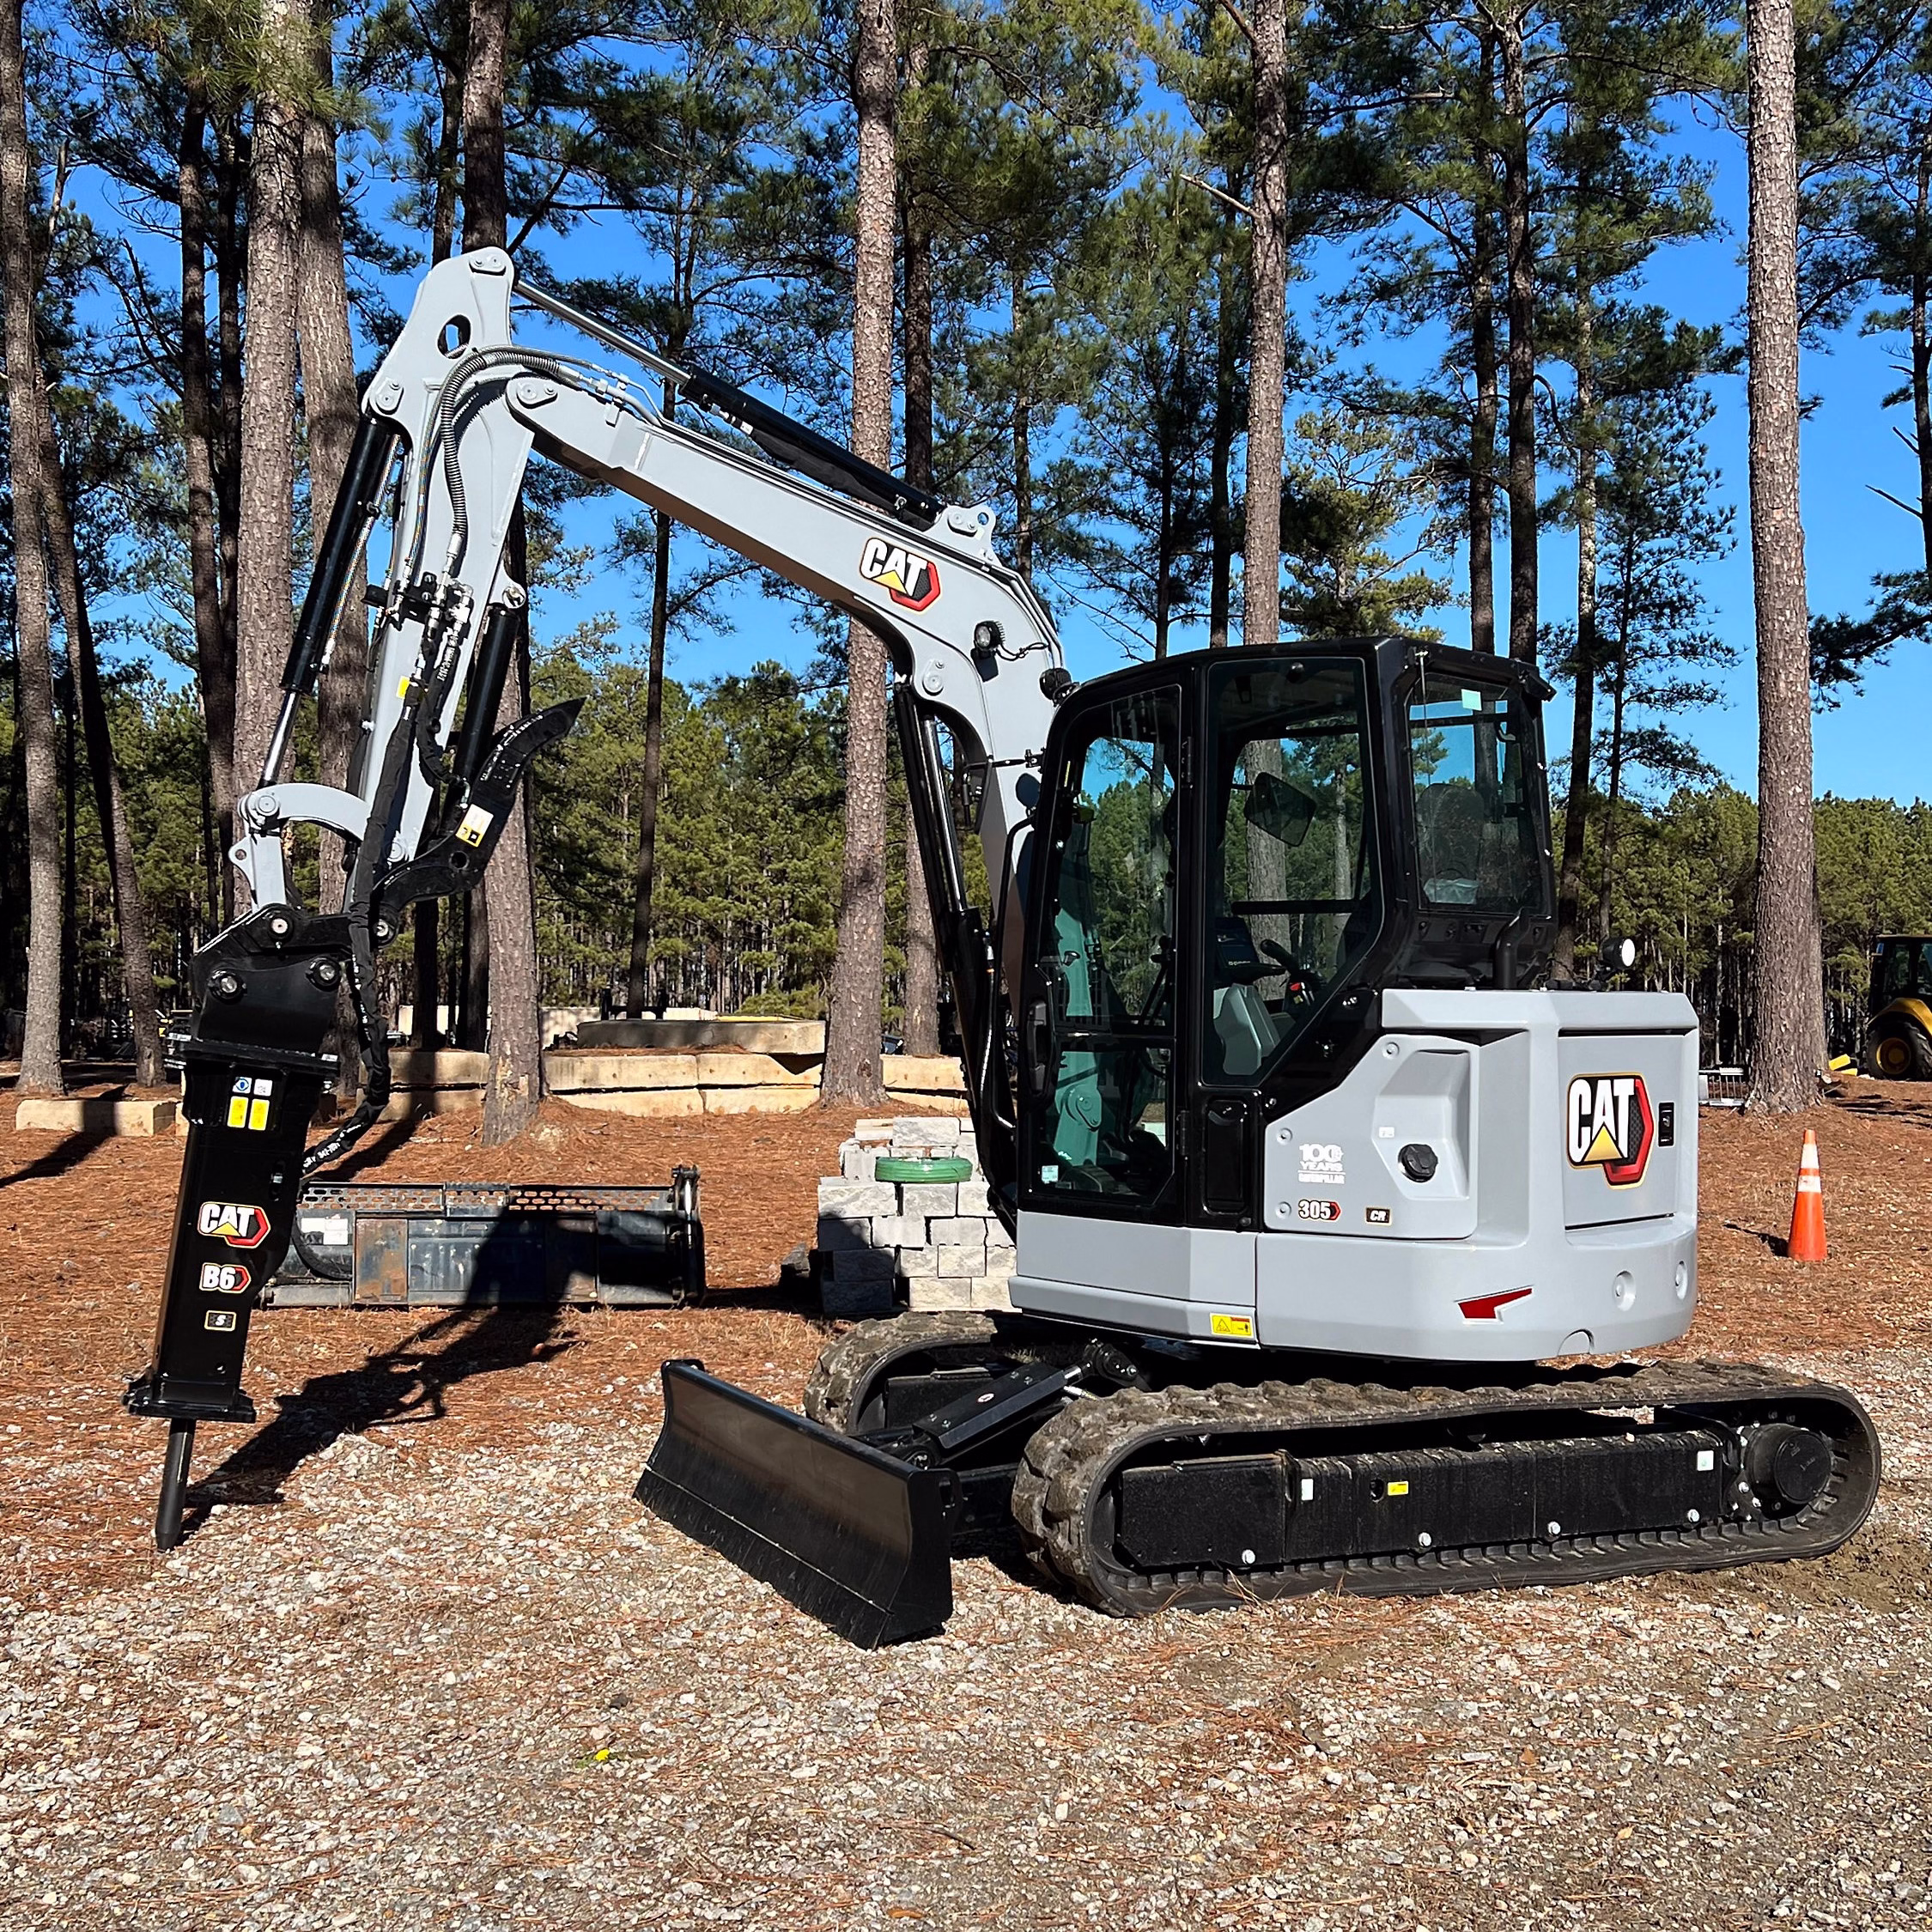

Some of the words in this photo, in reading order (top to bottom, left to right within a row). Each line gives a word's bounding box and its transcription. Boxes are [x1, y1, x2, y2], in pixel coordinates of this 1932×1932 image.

[860, 538, 928, 596] CAT
[1569, 1078, 1635, 1163] CAT
[1298, 1143, 1345, 1163] 100
[1299, 1160, 1344, 1172] YEARS
[199, 1203, 255, 1236] CAT
[1298, 1200, 1331, 1219] 305
[1370, 1210, 1387, 1221] CR
[203, 1265, 236, 1290] B6
[215, 1315, 227, 1326] S
